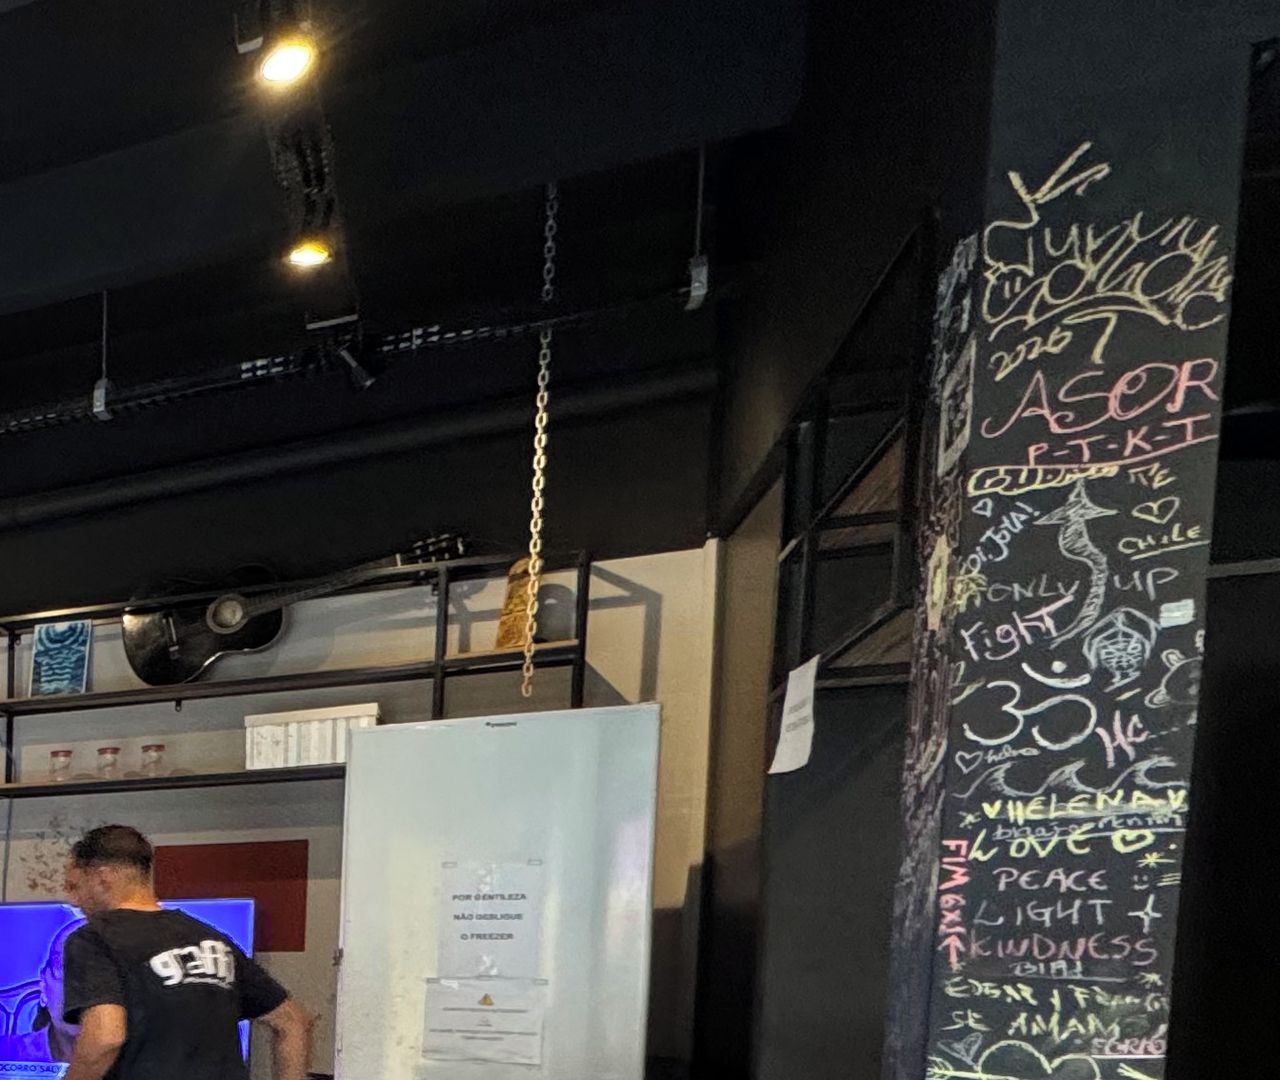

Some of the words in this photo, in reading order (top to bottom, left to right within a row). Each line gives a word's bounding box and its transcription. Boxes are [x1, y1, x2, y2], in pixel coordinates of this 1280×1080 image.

[1114, 567, 1179, 600] UP
[1008, 789, 1168, 826] HELENA
[939, 839, 971, 891] FIM
[993, 867, 1108, 893] PEACE
[973, 898, 1113, 927] LIGHT
[470, 933, 514, 941] FREEZER
